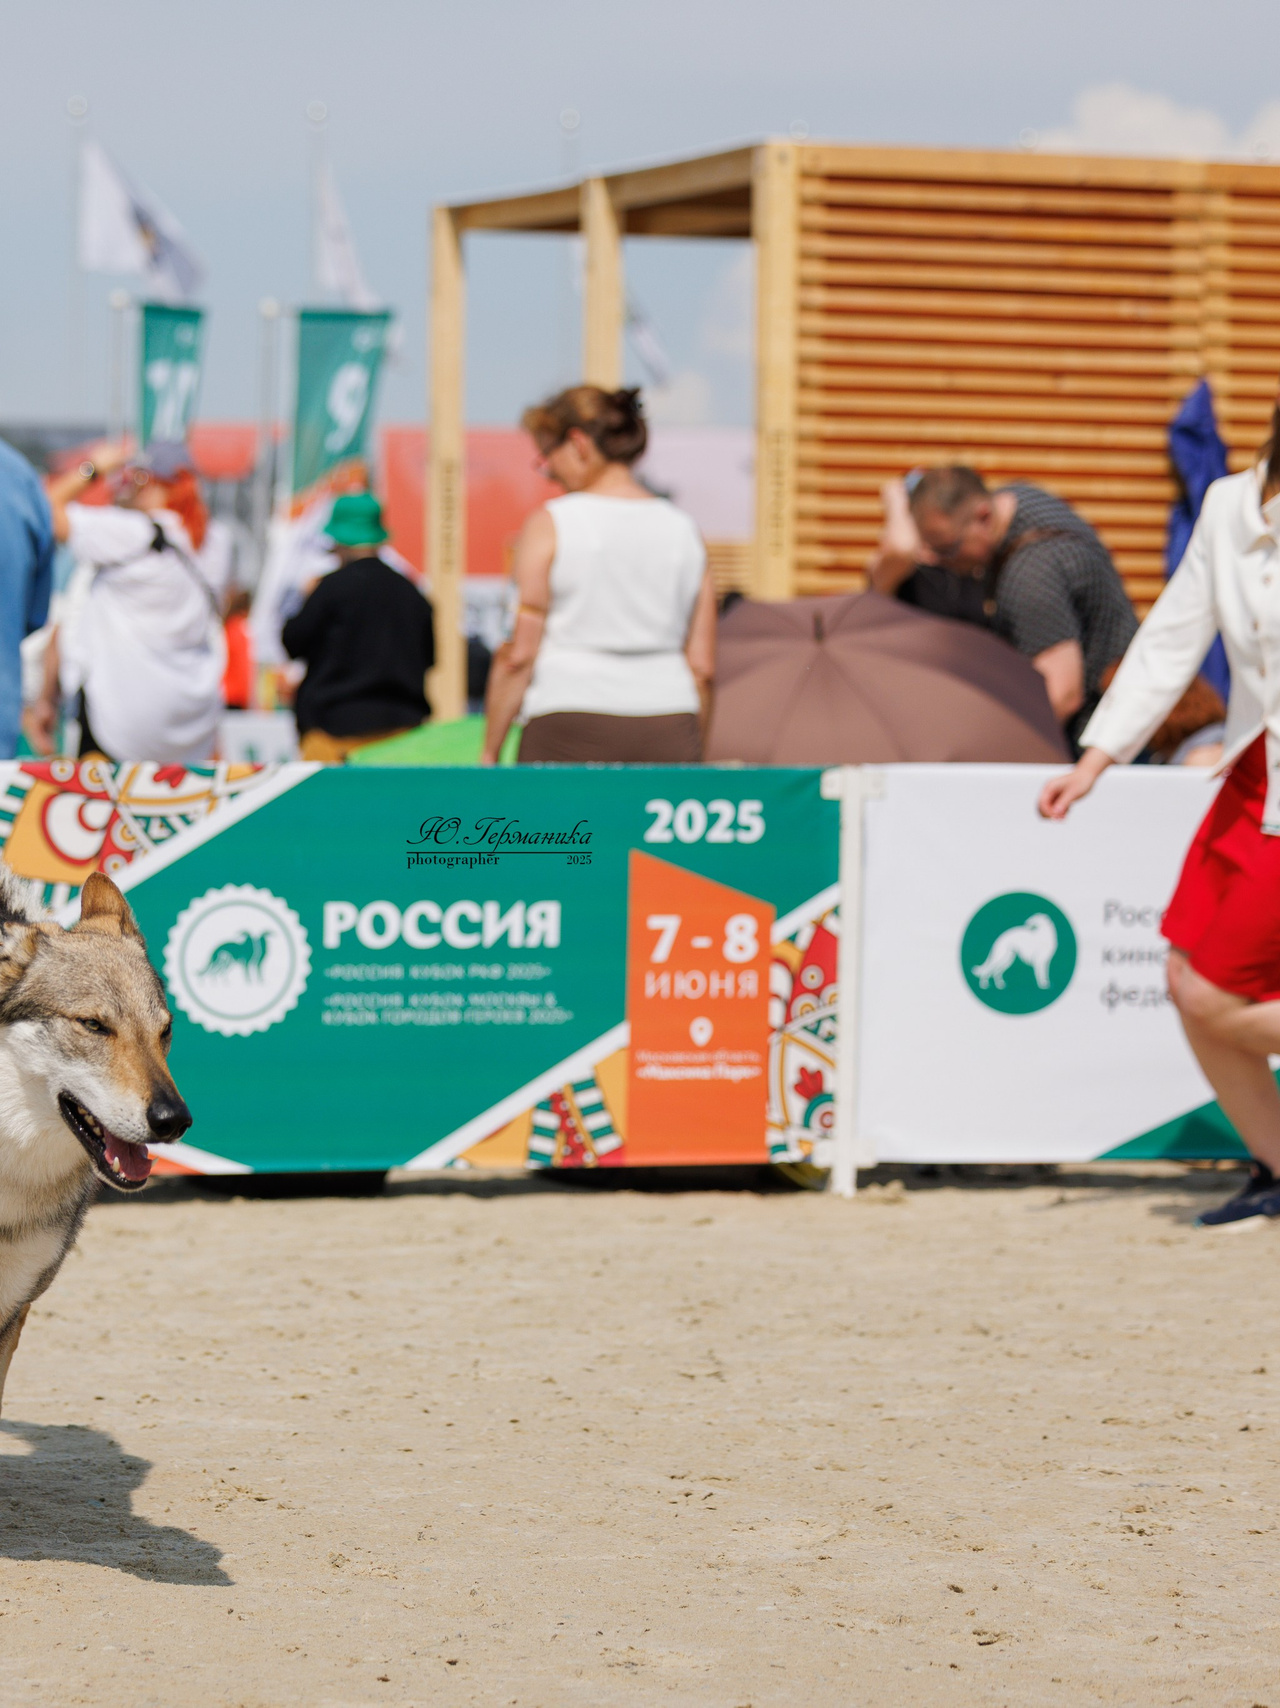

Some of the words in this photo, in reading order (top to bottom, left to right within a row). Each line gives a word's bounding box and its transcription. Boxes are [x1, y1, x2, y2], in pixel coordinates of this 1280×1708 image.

[643, 798, 766, 844] 2025
[322, 899, 562, 950] РОССИЯ
[644, 969, 759, 1000] ИЮНЯ
